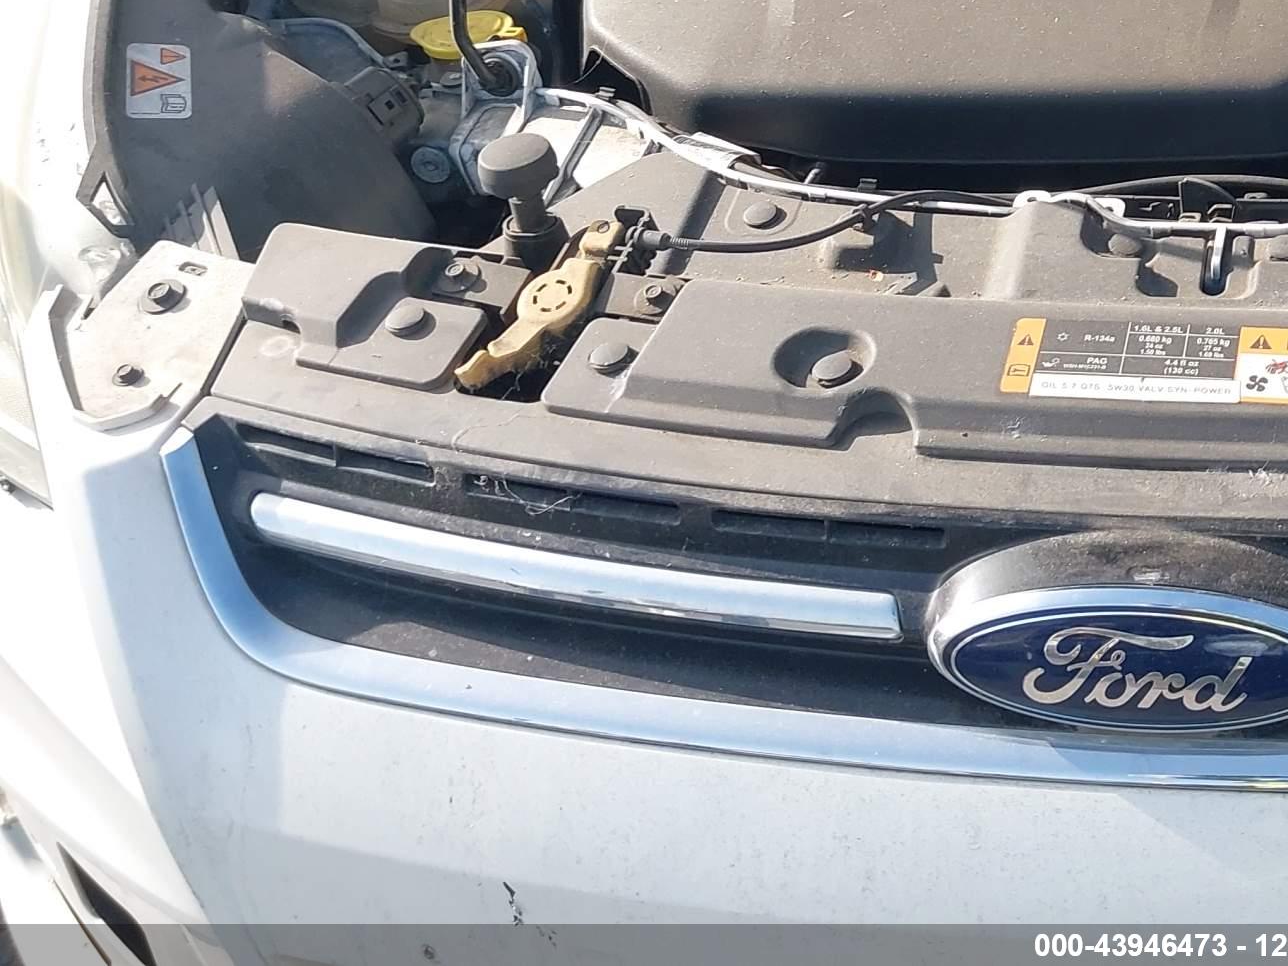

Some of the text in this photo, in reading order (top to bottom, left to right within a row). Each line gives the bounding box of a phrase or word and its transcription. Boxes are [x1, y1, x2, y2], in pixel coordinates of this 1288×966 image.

[1134, 324, 1152, 332] 1.6L
[1084, 334, 1115, 342] R-134a
[1161, 336, 1172, 345] kg
[1196, 337, 1230, 347] 0.765 kg
[1086, 357, 1108, 365] PAG
[1163, 367, 1183, 375] (130
[1041, 380, 1057, 389] OIL
[1022, 626, 1253, 714] Ford
